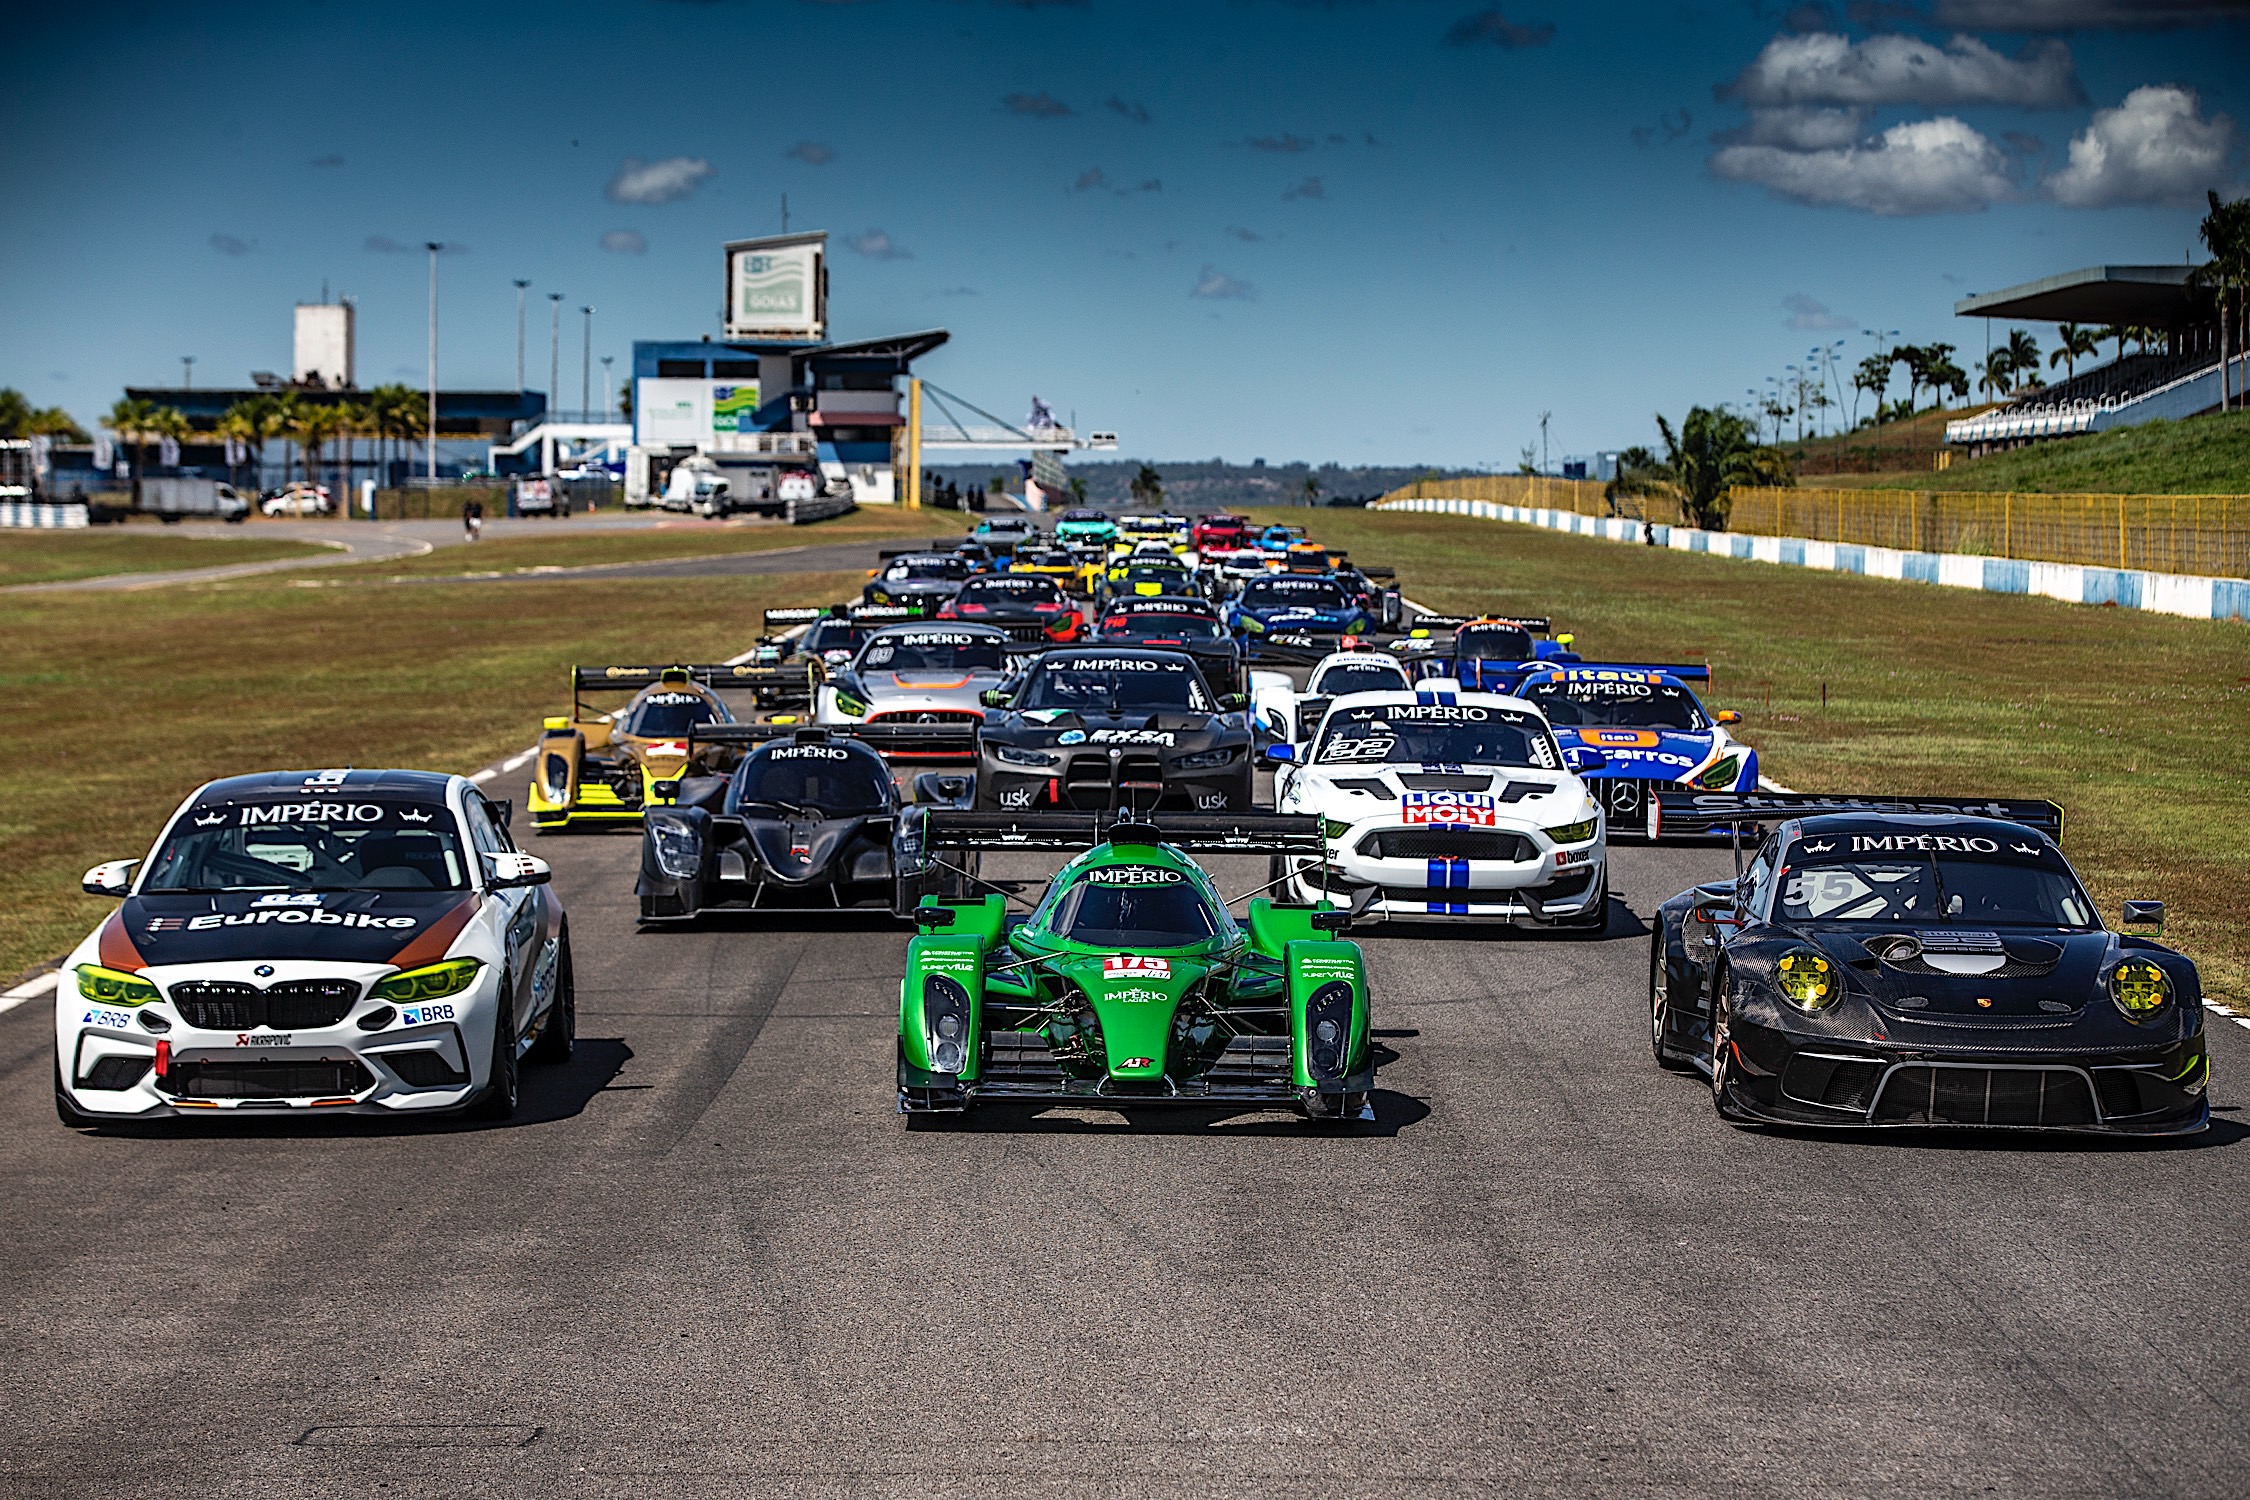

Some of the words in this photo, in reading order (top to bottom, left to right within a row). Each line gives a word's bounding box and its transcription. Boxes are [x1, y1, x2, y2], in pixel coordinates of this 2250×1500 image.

[1072, 658, 1159, 671] IMPÉRIO
[1567, 682, 1652, 696] IMPÉRIO
[1387, 704, 1488, 721] IMPÉRIO
[1405, 792, 1491, 808] LIQUI
[239, 800, 384, 826] IMPÉRIO
[1406, 806, 1493, 825] MOLY
[1851, 834, 1999, 853] IMPÉRIO
[1567, 850, 1591, 865] boxer
[1783, 874, 1854, 906] 55
[187, 908, 417, 931] Eurobike
[1105, 956, 1168, 970] 175
[97, 1011, 131, 1028] BRB
[421, 1005, 455, 1022] BRB
